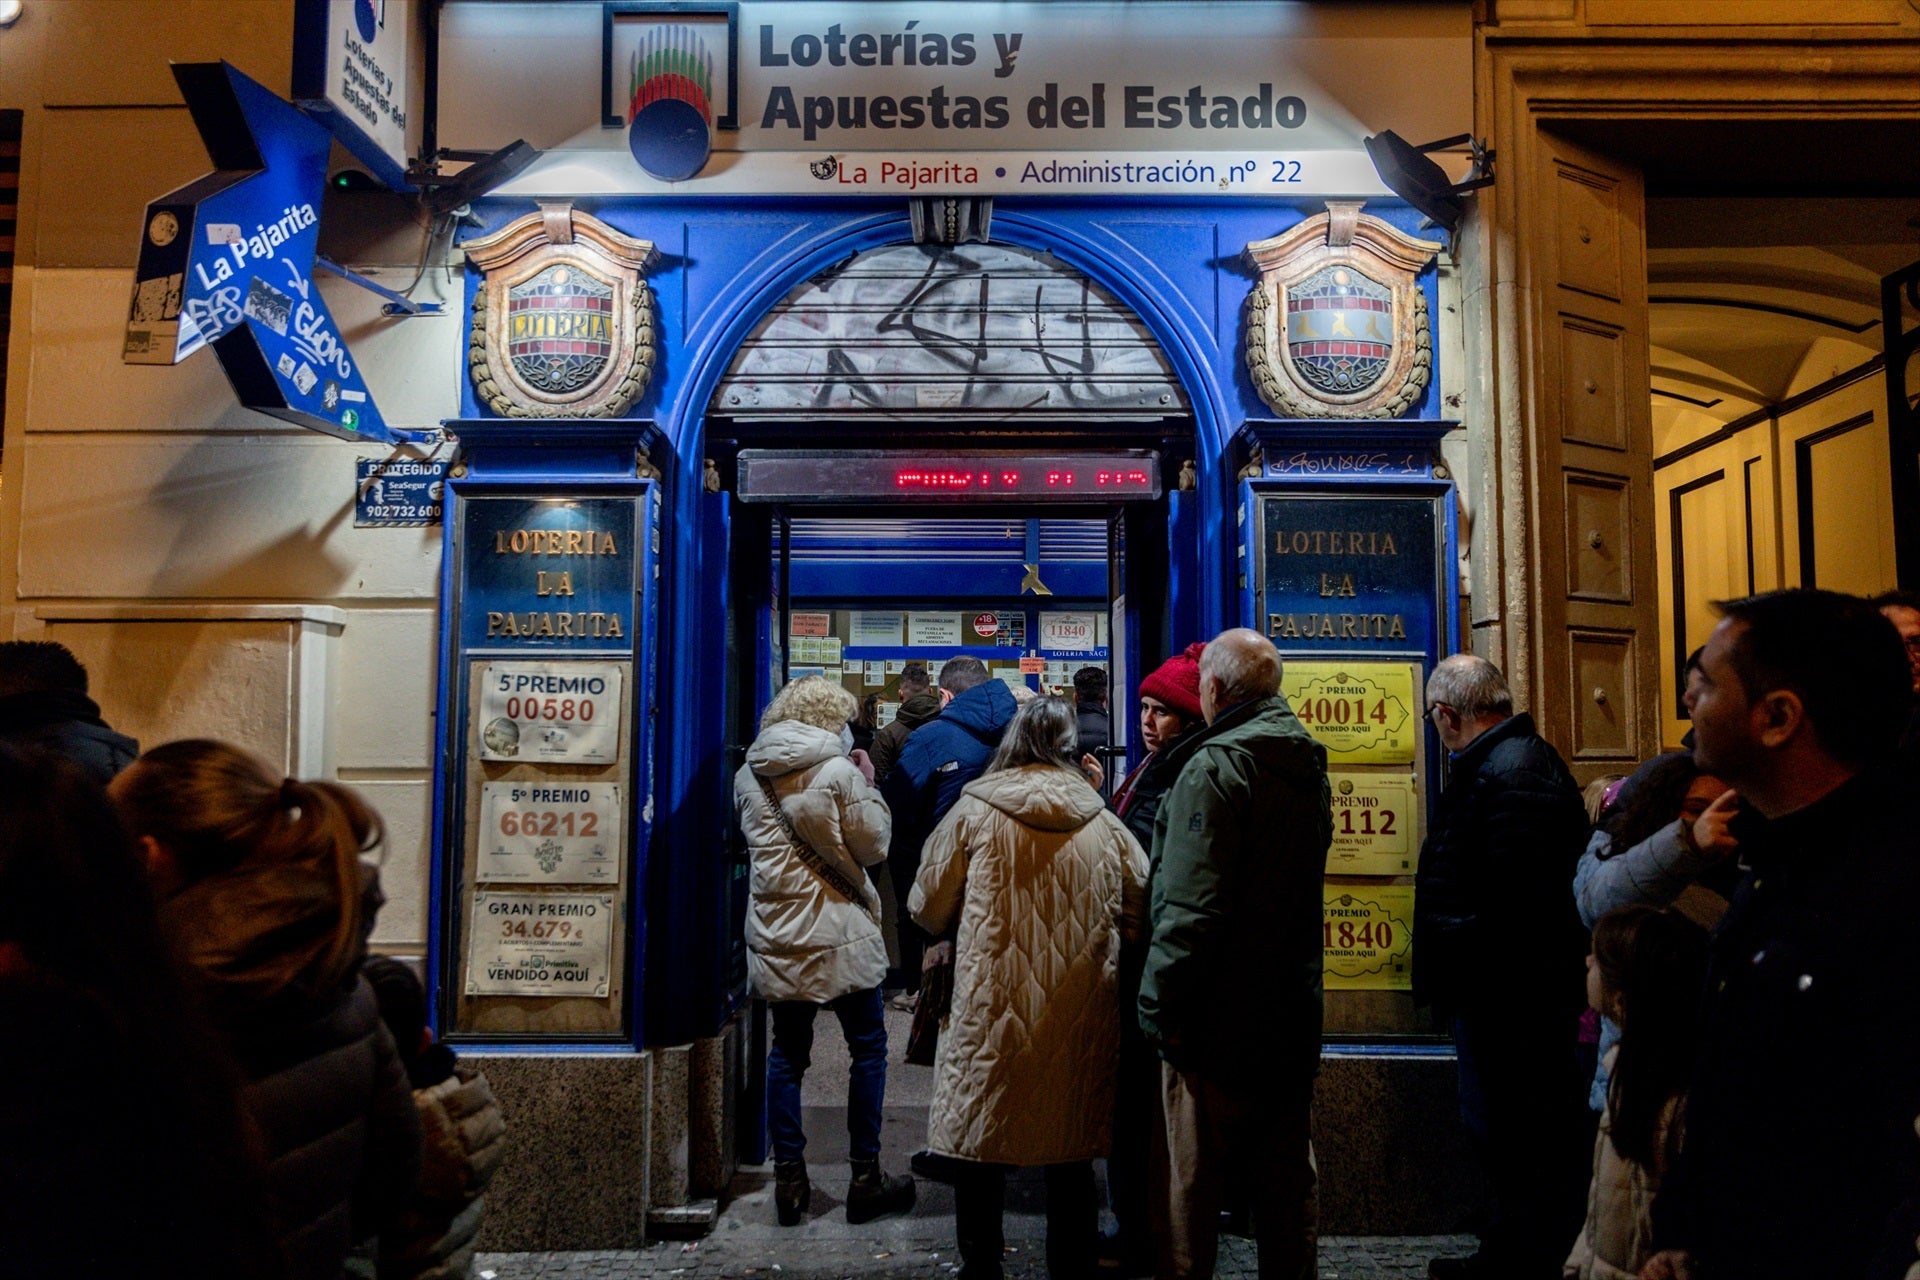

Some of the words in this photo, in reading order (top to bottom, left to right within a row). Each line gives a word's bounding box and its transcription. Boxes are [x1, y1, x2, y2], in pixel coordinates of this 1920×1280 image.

[760, 20, 977, 67] Loterías
[992, 33, 1023, 78] y
[343, 55, 390, 114] Apuestas
[392, 105, 406, 131] del
[386, 77, 393, 97] y
[342, 78, 378, 126] Estado
[760, 85, 1010, 141] Apuestas
[1027, 83, 1106, 129] del
[1124, 83, 1307, 129] Estado
[837, 161, 867, 184] La
[881, 160, 978, 190] Pajarita
[1020, 160, 1215, 184] Administración
[1229, 160, 1256, 183] nº
[1271, 160, 1302, 183] 22
[195, 257, 233, 291] La
[229, 203, 317, 269] Pajarita
[511, 313, 609, 338] LOTERIA
[369, 464, 442, 476] PROTEGIDO
[388, 481, 427, 491] SeaSegur
[366, 505, 390, 517] 902
[392, 505, 416, 517] 732
[418, 505, 441, 517] 600
[496, 529, 618, 555] LOTERIA
[1276, 531, 1398, 556] LOTERIA
[537, 571, 575, 596] LA
[1320, 573, 1357, 597] LA
[487, 612, 624, 638] PAJARITA
[1051, 625, 1086, 637] 11840
[1269, 614, 1407, 639] PAJARITA
[1327, 686, 1366, 694] PREMIO
[506, 697, 594, 721] 00580
[1297, 698, 1387, 725] 40014
[532, 789, 590, 803] PREMIO
[1331, 796, 1379, 807] PREMIO
[500, 811, 598, 837] 66212
[489, 903, 533, 916] GRAN
[538, 904, 597, 917] PREMIO
[1331, 909, 1371, 917] PREMIO
[502, 920, 572, 939] 34.679
[575, 929, 583, 939] €
[488, 969, 549, 981] VENDIDO
[553, 967, 590, 982] AQUÍ
[545, 960, 579, 968] Primitiva
